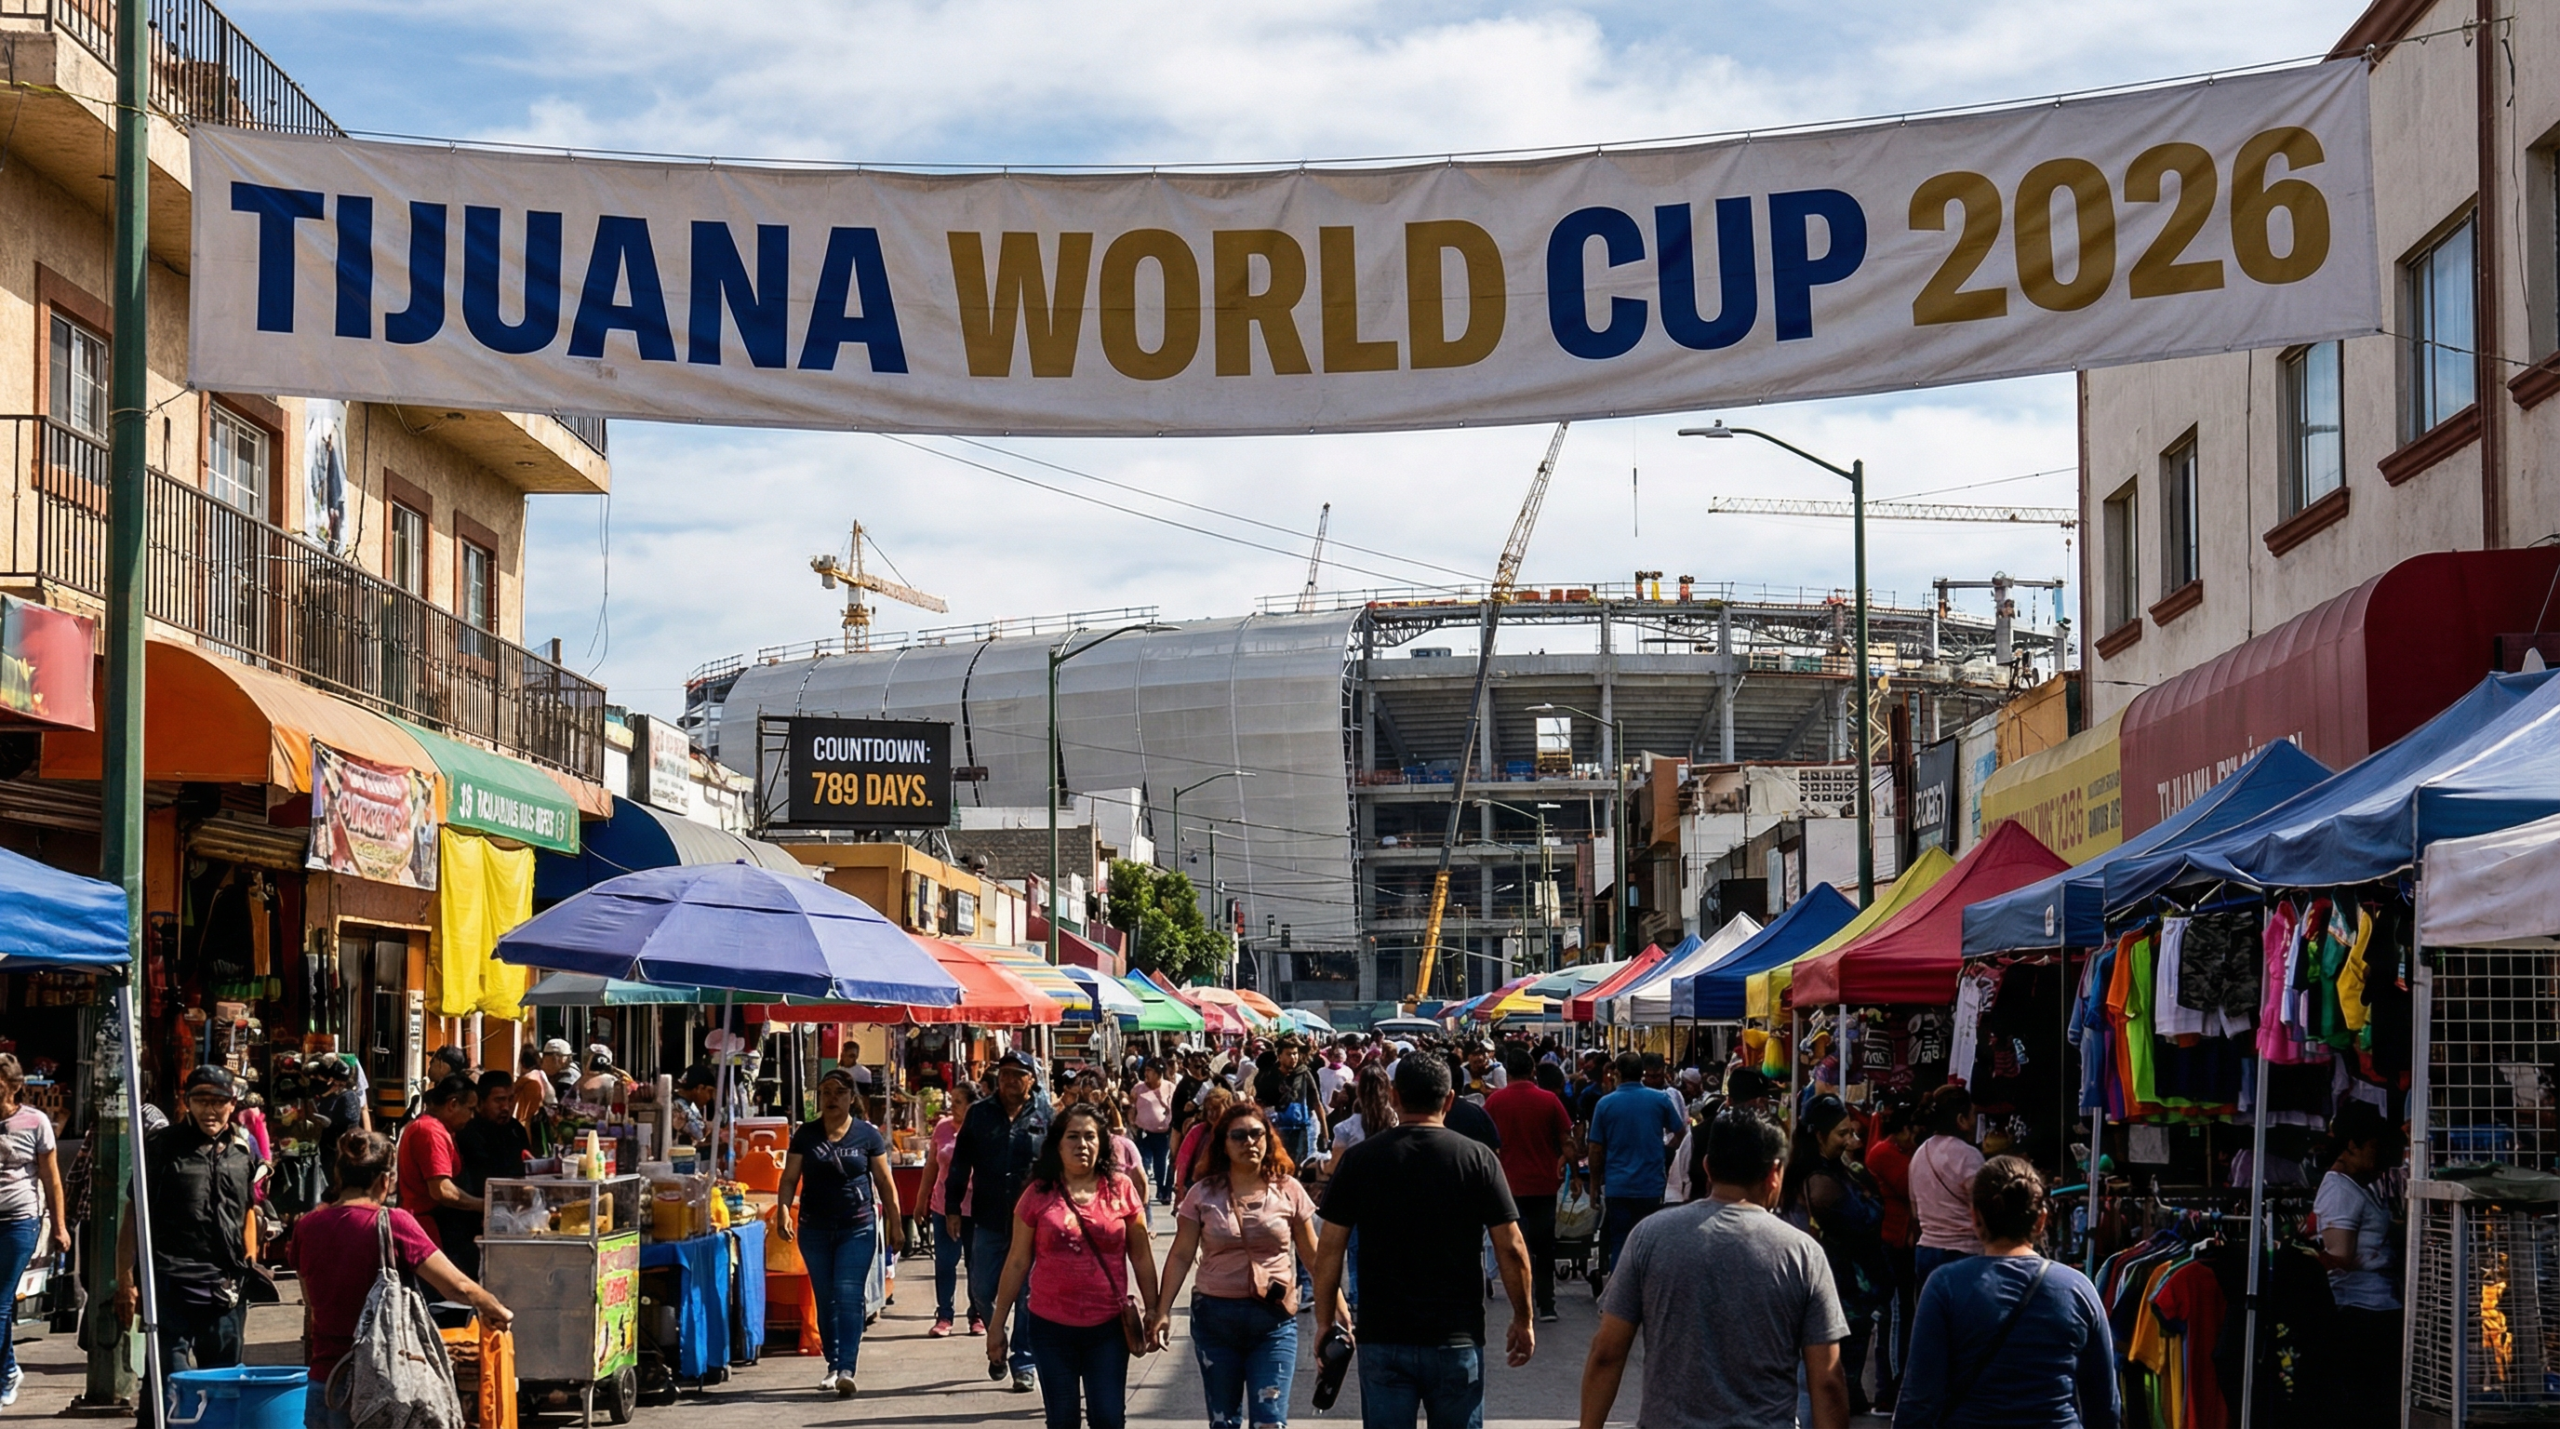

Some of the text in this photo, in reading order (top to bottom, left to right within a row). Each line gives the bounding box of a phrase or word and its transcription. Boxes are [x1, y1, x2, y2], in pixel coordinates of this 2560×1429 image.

[233, 128, 2328, 379] TIJUANA WORLD CUP 2026
[813, 736, 931, 764] COUNTDOWN:
[812, 771, 933, 807] 789 DAYS.
